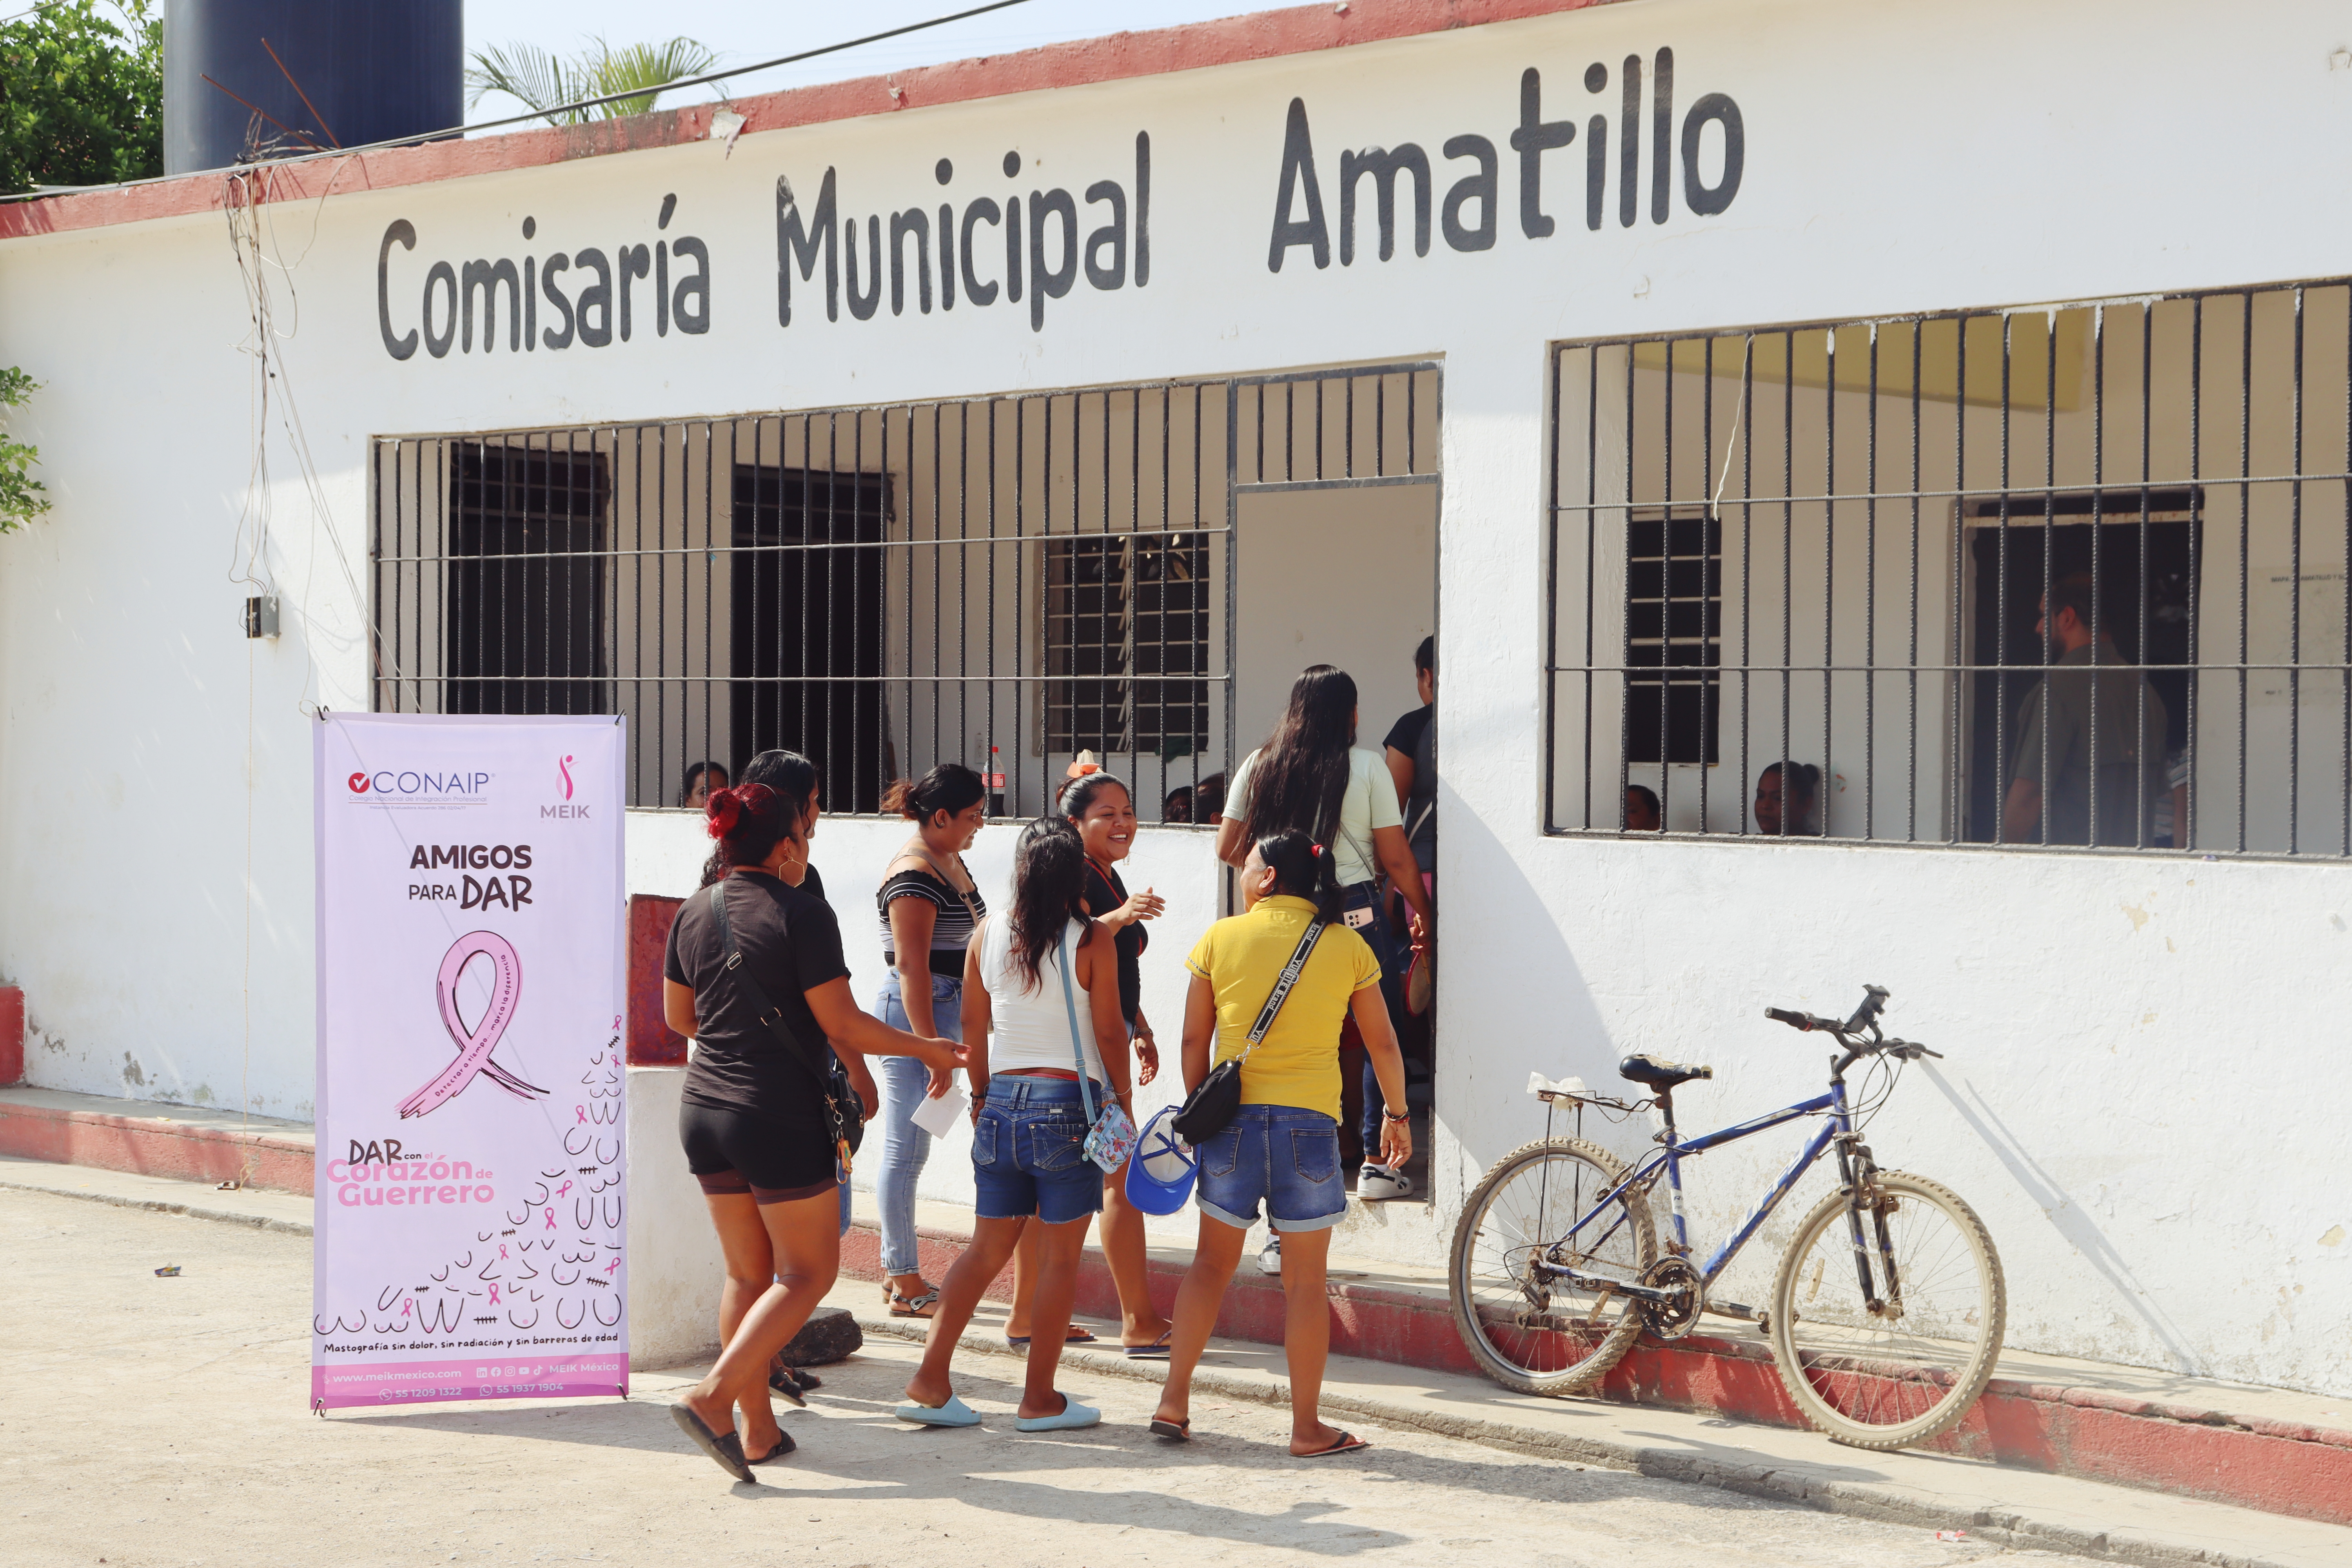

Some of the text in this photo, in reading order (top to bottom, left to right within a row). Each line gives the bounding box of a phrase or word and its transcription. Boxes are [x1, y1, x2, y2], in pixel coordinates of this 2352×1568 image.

[379, 46, 1745, 361] Comisaría Municipal Amatillo
[373, 771, 488, 793] CONAIP
[541, 805, 590, 818] MEIK
[410, 845, 532, 869] AMIGOS
[409, 875, 533, 912] PARA DAR
[1307, 924, 1320, 941] Brand
[1269, 989, 1284, 1011] Brand
[348, 1139, 402, 1166] DAR
[327, 1155, 493, 1183] Corazón de
[338, 1183, 494, 1207] Guerrero
[324, 1342, 388, 1354] Mastografía
[410, 1341, 437, 1349] dolor,
[458, 1338, 504, 1347] radiación
[507, 1339, 512, 1348] y
[533, 1336, 577, 1345] barreras
[581, 1334, 592, 1342] de
[595, 1332, 618, 1341] edad
[333, 1370, 462, 1383] www.meikmexico.com
[550, 1362, 619, 1373] MEIK México
[395, 1387, 462, 1398] 55 1209 1322
[496, 1383, 564, 1394] 55 1937 1904
